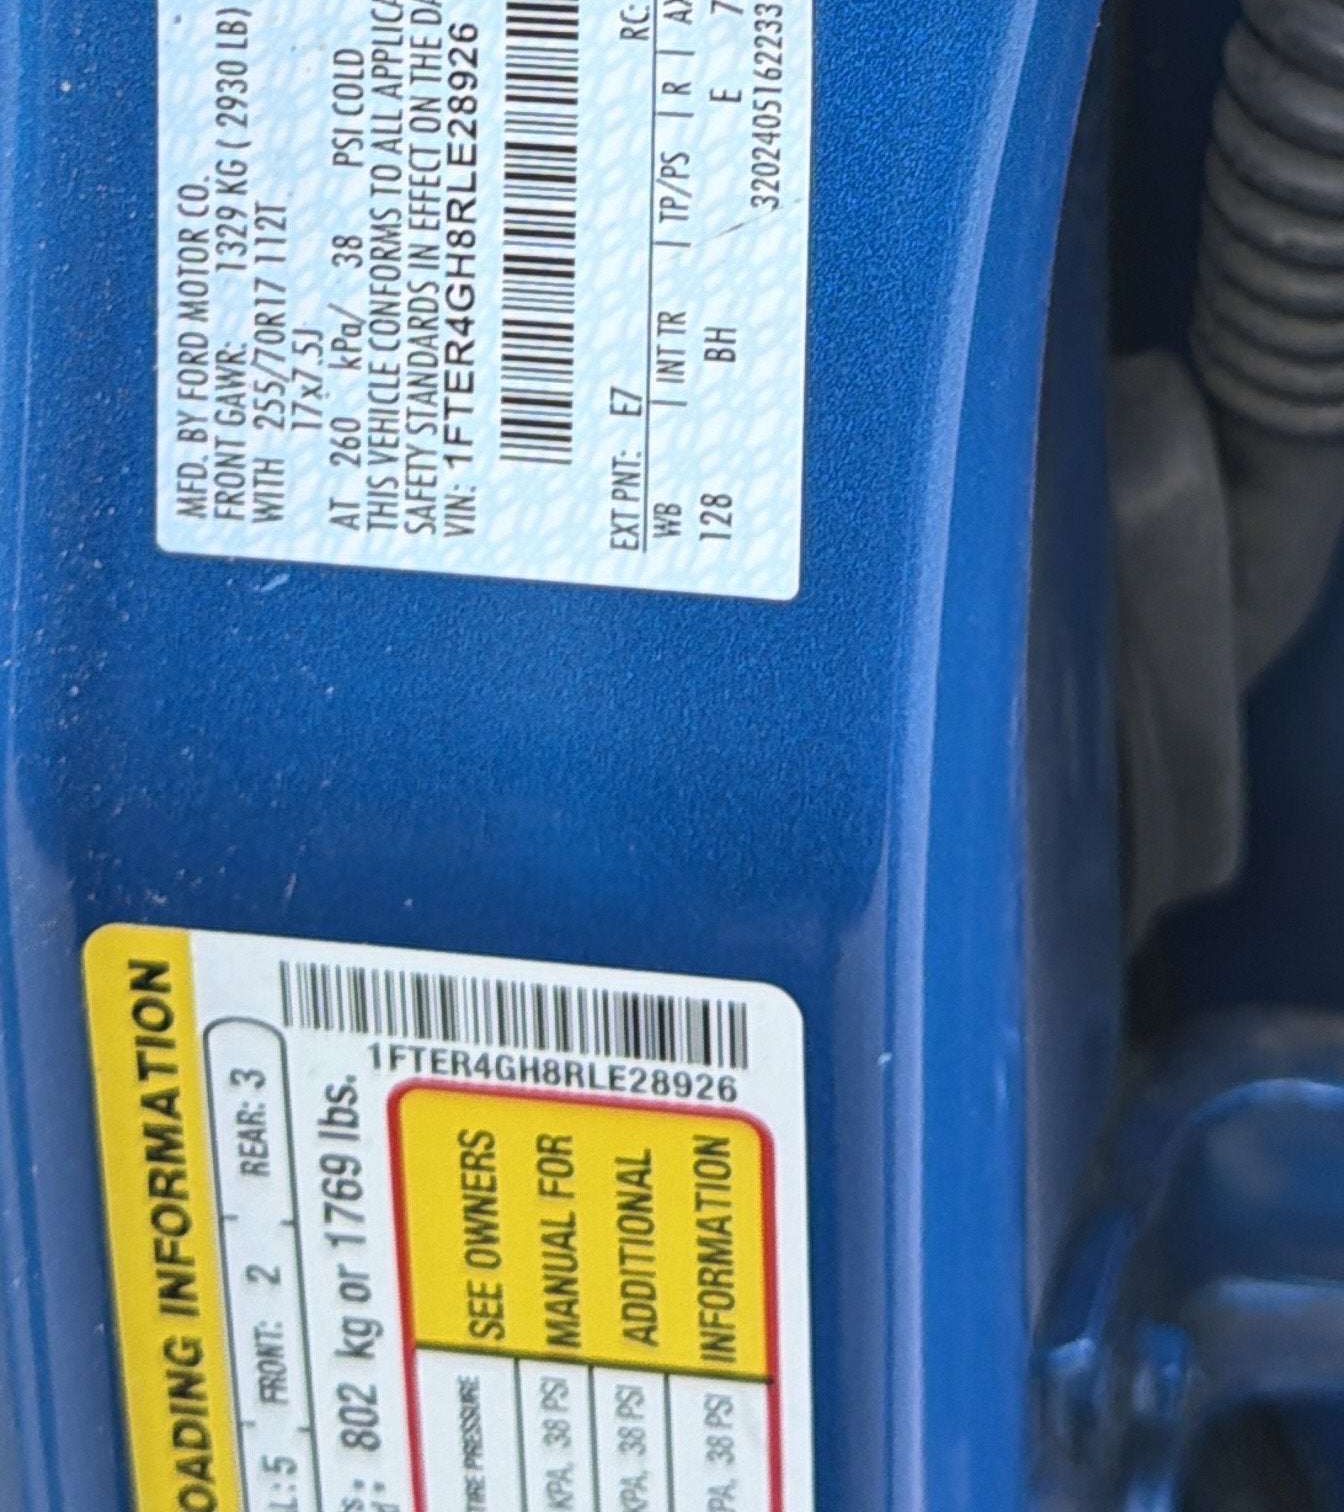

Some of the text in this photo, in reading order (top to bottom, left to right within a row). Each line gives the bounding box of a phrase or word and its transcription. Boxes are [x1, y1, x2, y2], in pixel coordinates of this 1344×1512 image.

[619, 5, 650, 41] RC:
[410, 37, 443, 84] THE
[662, 81, 691, 95] R
[709, 87, 742, 103] E
[370, 109, 403, 155] ALL
[409, 96, 442, 134] ON
[750, 2, 783, 210] 3202405162233
[370, 164, 403, 197] TO
[409, 143, 441, 230] EFFECT
[656, 151, 692, 223] TP/PS
[214, 7, 252, 521] FRONT GAWR: 1329 KG ( 2930 LB)
[327, 48, 367, 531] AT 260 kPa/ 38 PSI COLD
[369, 208, 403, 351] CONFORMS
[408, 244, 441, 271] IN
[443, 23, 478, 537] VIN: 1FTER4GH8RLE28926
[176, 175, 210, 519] MFD. BY FORD MOTOR CO.
[250, 201, 290, 524] WITH 255/70R17 112T
[291, 327, 324, 431] 17x7.5J
[405, 281, 440, 435] STANDARDS
[656, 311, 686, 384] INT TR
[703, 326, 736, 363] BH
[367, 362, 401, 466] VEHICLE
[405, 443, 439, 535] SAFETY
[610, 386, 642, 550] EXT PNT: E7
[367, 477, 400, 533] THIS
[654, 502, 682, 538] WB
[699, 493, 732, 543] 128
[317, 1075, 360, 1141] lbs.
[367, 1042, 739, 1103] 1FTER4GH8RLE28926
[127, 959, 200, 1317] INFORMATION
[230, 1068, 270, 1177] REAR: 3
[319, 1154, 366, 1248] 1769
[457, 1129, 506, 1341] SEE OWNERS
[536, 1133, 582, 1349] MANUAL FOR
[615, 1149, 659, 1347] ADDITIONAL
[693, 1133, 736, 1363] INFORMATION
[337, 1264, 372, 1303] or
[245, 1264, 288, 1405] FRONT: 2
[334, 1317, 384, 1360] kg
[336, 1383, 381, 1452] 802
[457, 1375, 485, 1470] PRESSURE
[540, 1376, 569, 1412] PSI
[615, 1383, 645, 1420] PSI
[703, 1392, 734, 1429] PSI
[542, 1418, 571, 1447] 38
[616, 1426, 647, 1457] 38
[705, 1435, 735, 1466] 38
